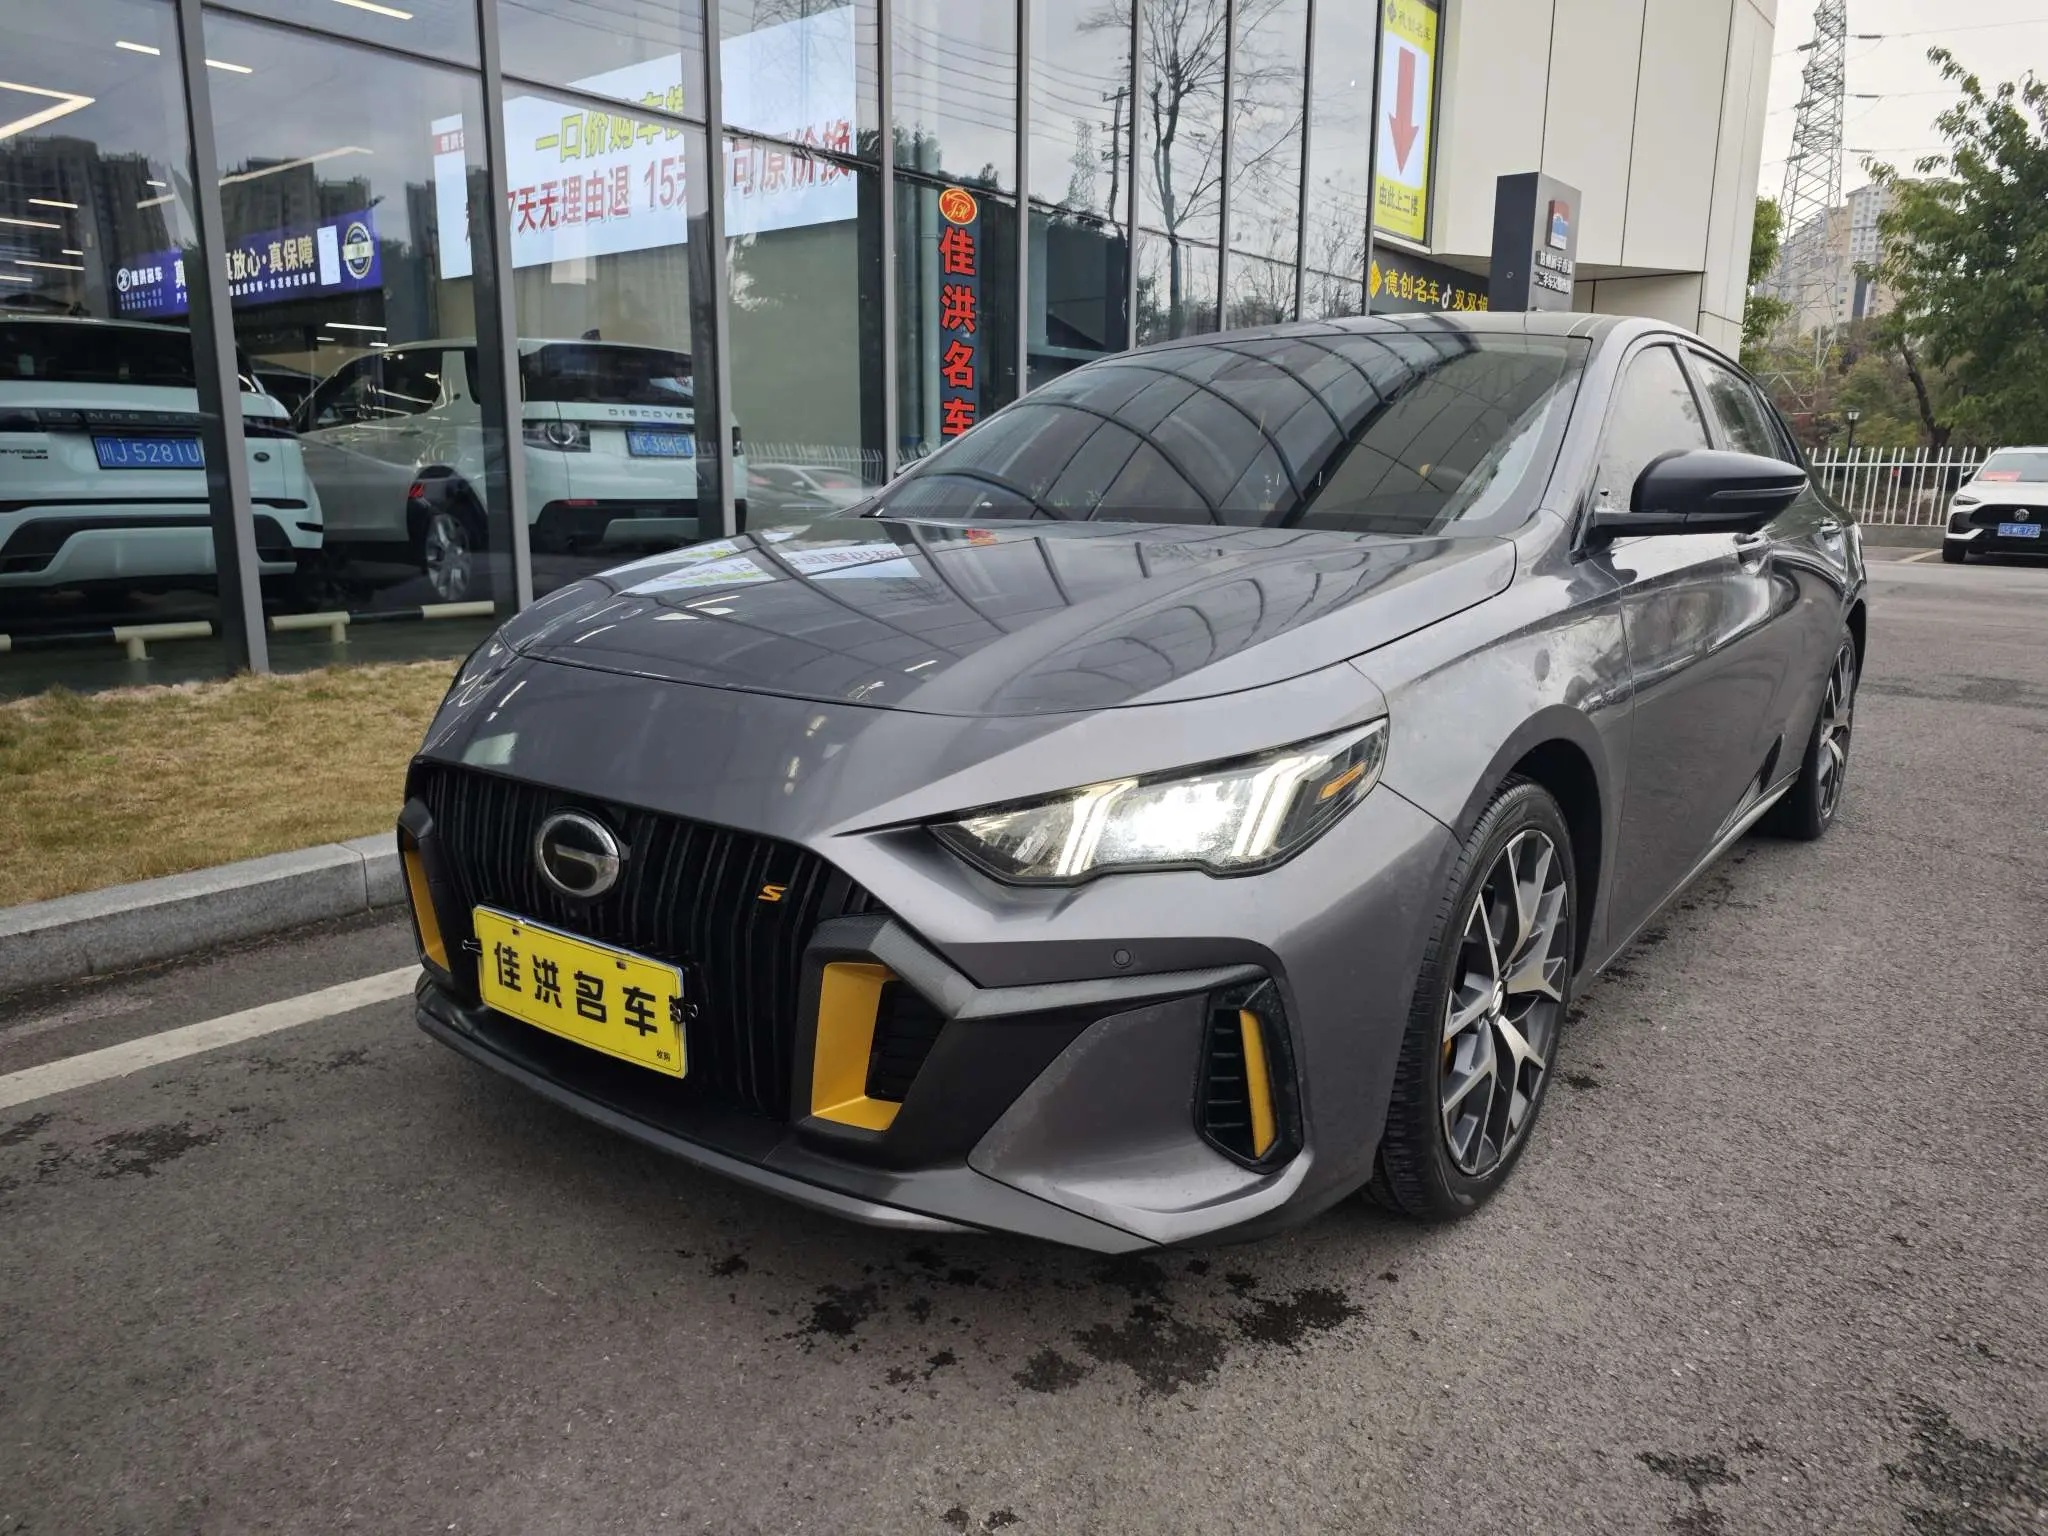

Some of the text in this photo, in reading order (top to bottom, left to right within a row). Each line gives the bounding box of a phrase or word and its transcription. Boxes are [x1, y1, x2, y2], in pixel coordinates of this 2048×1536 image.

[1384, 268, 1440, 305] 德创名车
[938, 226, 976, 435] 佳洪名车
[757, 884, 787, 901] S
[494, 941, 658, 1037] 佳洪名车
